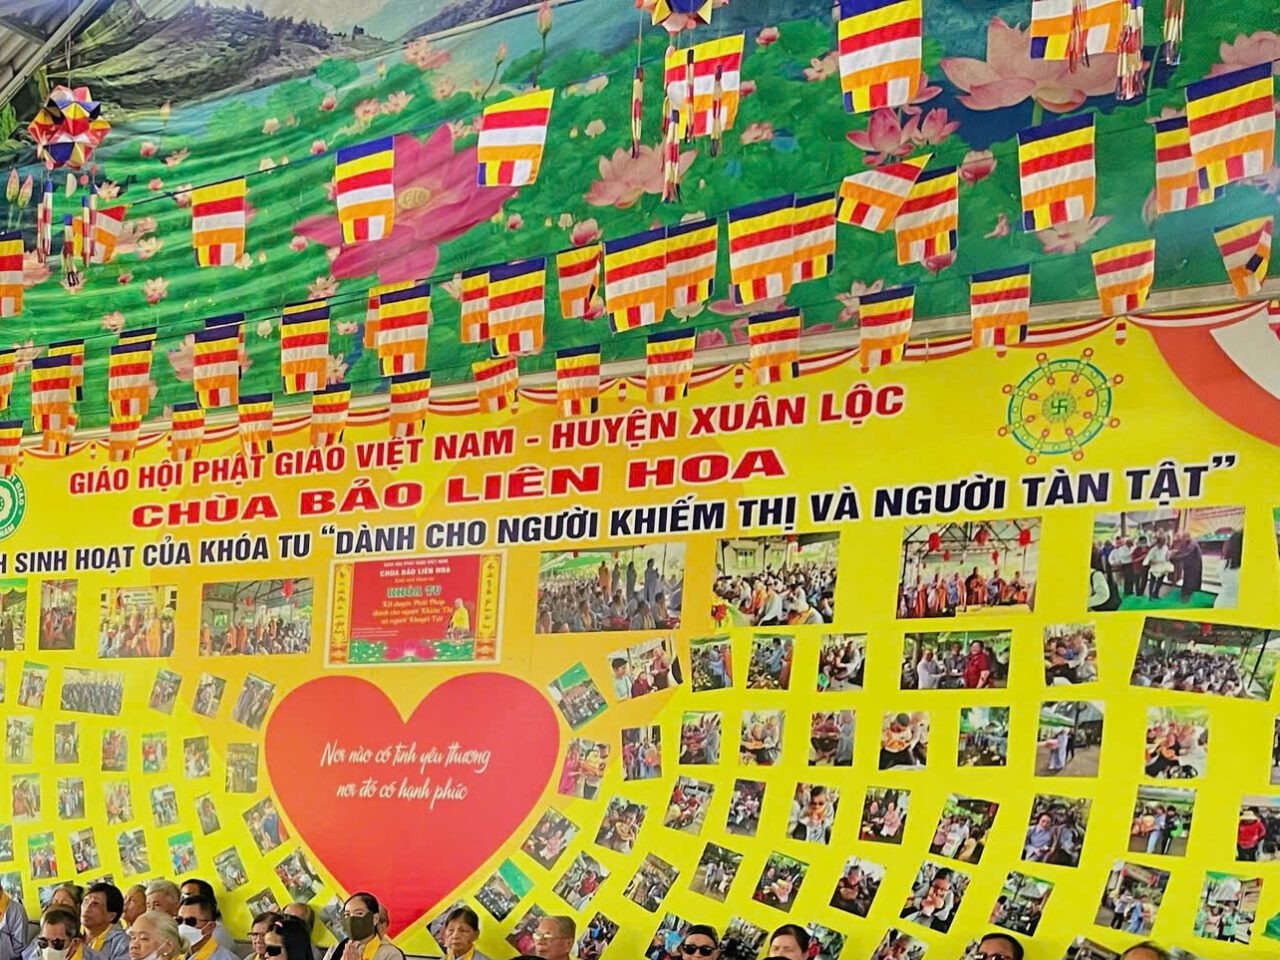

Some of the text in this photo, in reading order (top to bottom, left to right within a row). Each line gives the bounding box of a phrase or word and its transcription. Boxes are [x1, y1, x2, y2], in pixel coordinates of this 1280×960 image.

[70, 466, 130, 495] GIÁO
[138, 460, 182, 491] HỘI
[193, 453, 266, 485] PHẬT
[275, 446, 345, 476] GIÁO
[357, 436, 424, 470] VIỆT
[434, 429, 514, 460] NAM
[552, 409, 677, 449] HUYỆN
[690, 395, 807, 435] XUÂN
[821, 384, 904, 424] LỘC
[14, 549, 68, 573] SINH
[75, 546, 136, 574] HOẠT
[143, 536, 191, 566] CỦA
[200, 533, 269, 563] KHÓA
[278, 533, 310, 558] TU
[425, 520, 487, 548] CHO
[497, 506, 599, 544] NGƯỜI
[610, 495, 726, 537] KHIẾM
[738, 496, 797, 531] THỊ
[810, 486, 860, 522] VÀ
[874, 473, 1007, 517] NGƯỜI
[1022, 467, 1110, 507] TÀN
[132, 450, 785, 528] CHÙA BẢO LIÊN HOA
[320, 740, 345, 767] Nơi
[349, 745, 372, 763] nào
[375, 746, 392, 763] có
[420, 746, 443, 774] yêu
[359, 777, 377, 798] đó
[379, 781, 395, 798] có
[398, 777, 431, 802] hạnh
[431, 778, 468, 810] phúc
